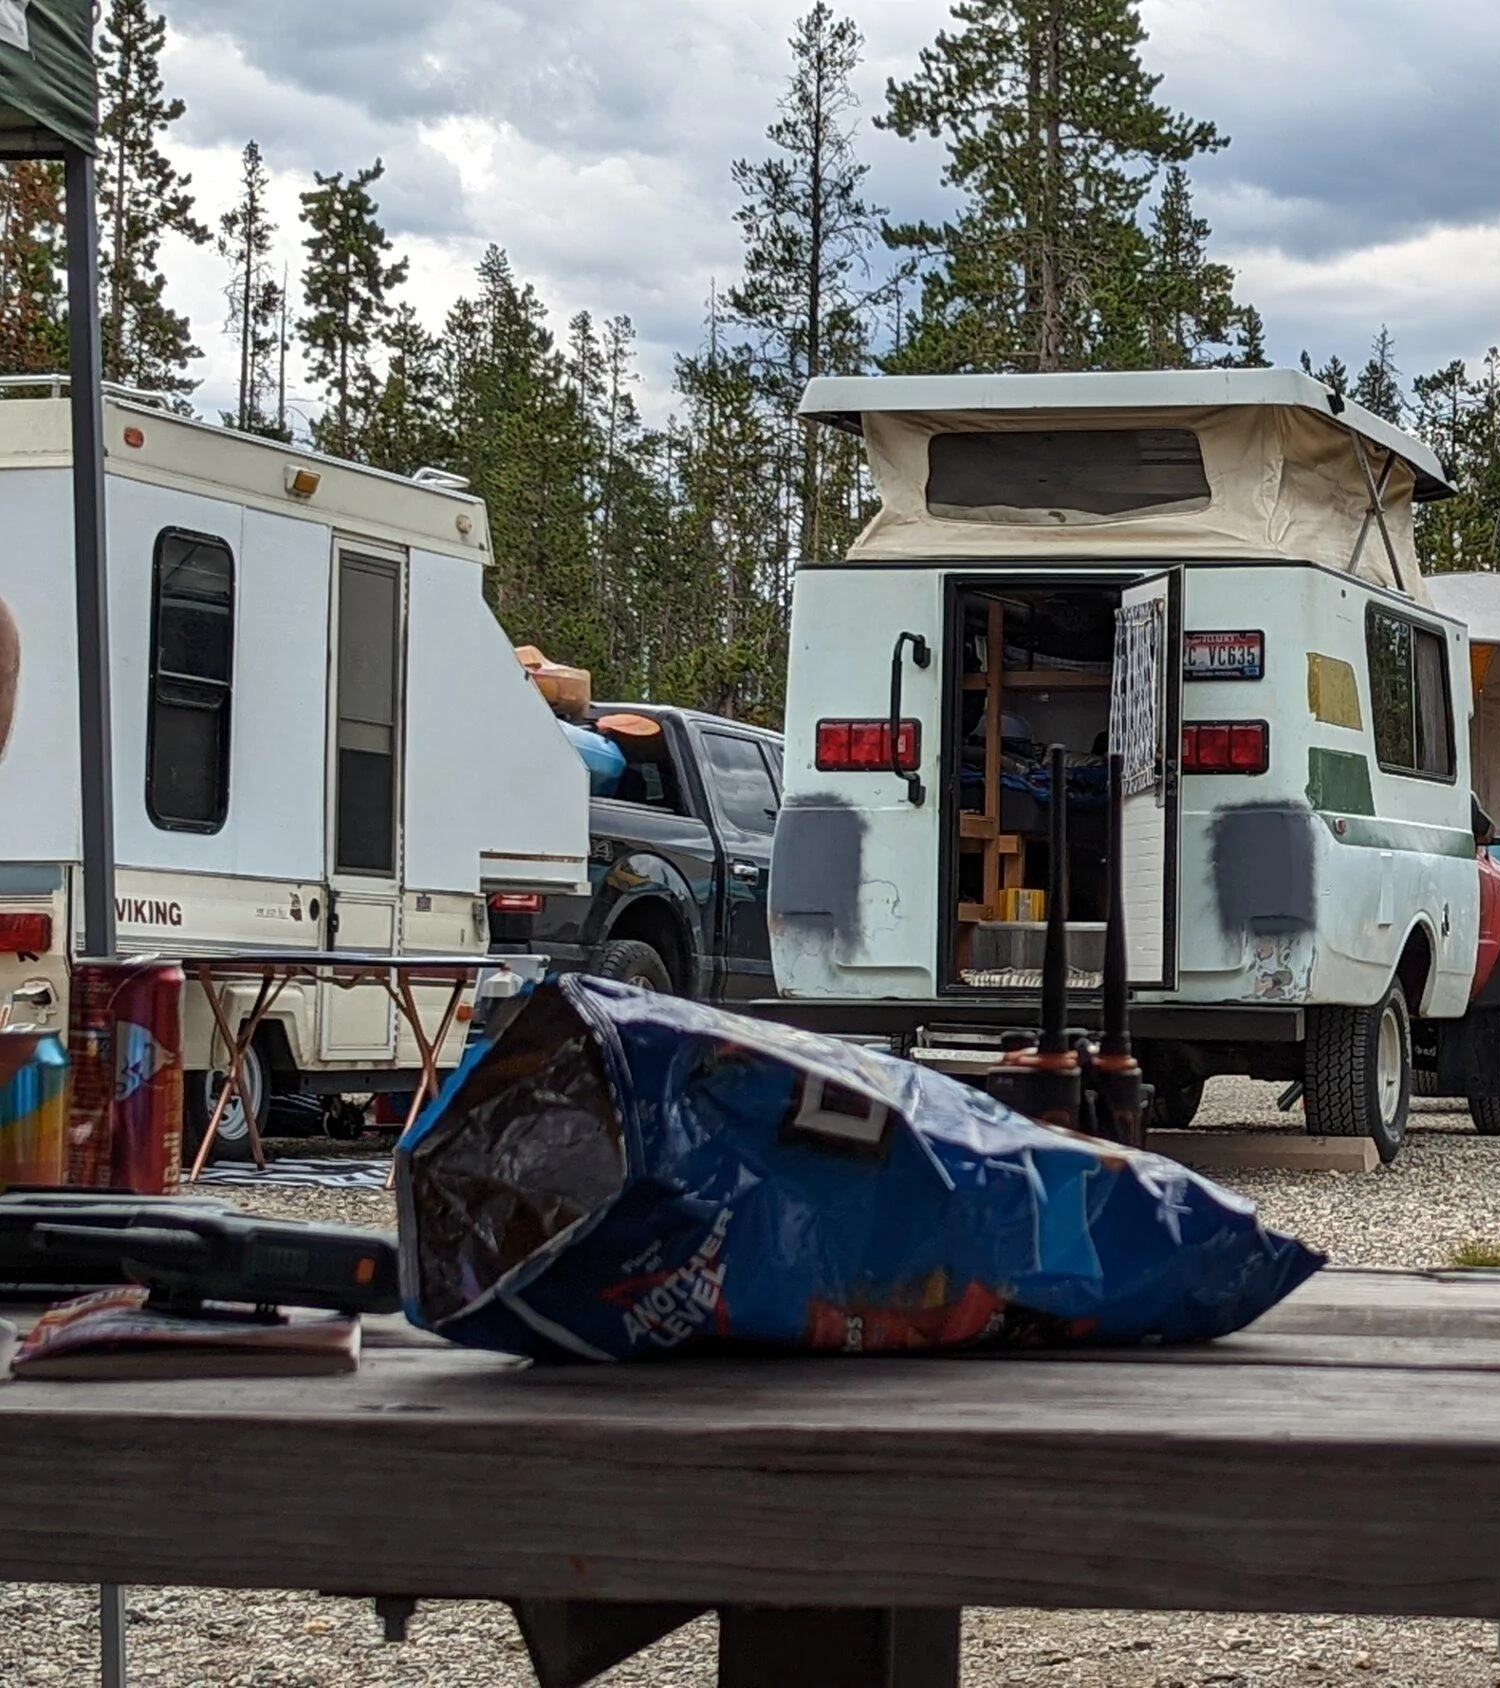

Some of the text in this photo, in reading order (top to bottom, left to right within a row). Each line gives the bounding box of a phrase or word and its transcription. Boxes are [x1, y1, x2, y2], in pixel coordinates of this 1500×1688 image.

[1209, 645, 1255, 667] VC635
[115, 898, 182, 926] VIKING
[622, 1207, 734, 1344] ANOTHER
[650, 1263, 728, 1347] LEVEL
